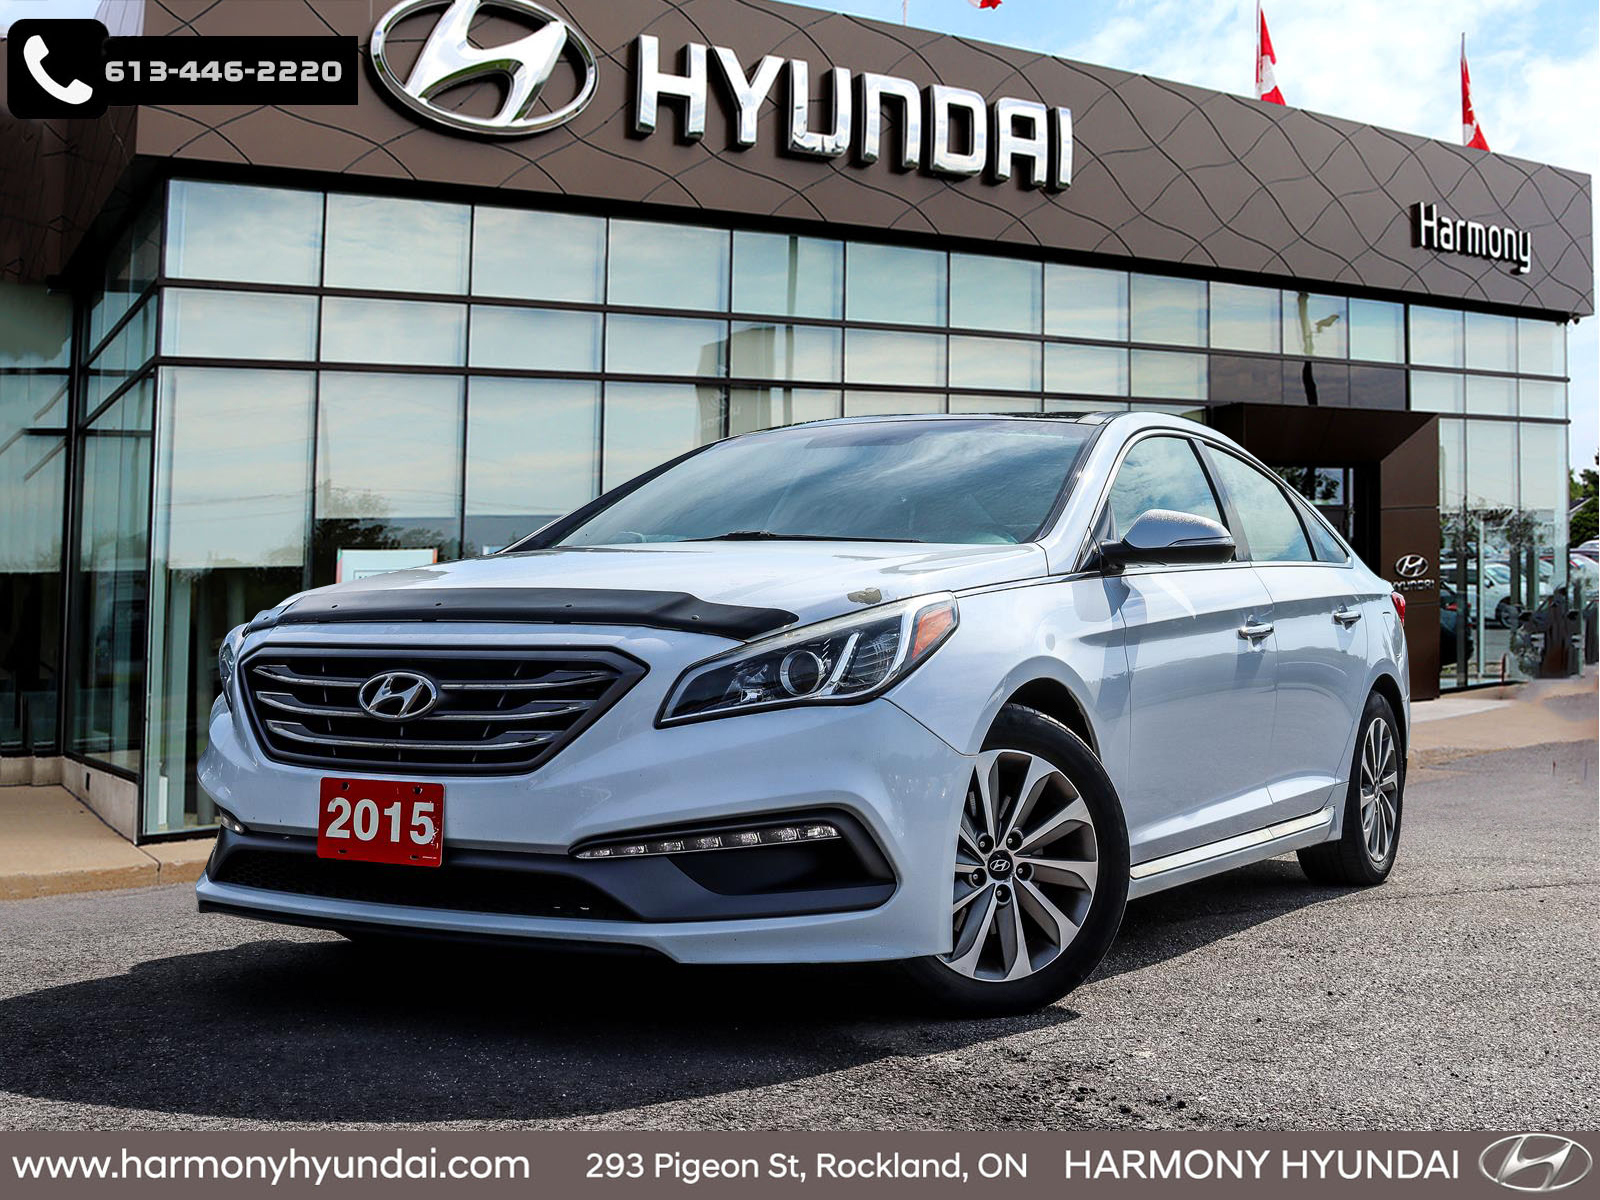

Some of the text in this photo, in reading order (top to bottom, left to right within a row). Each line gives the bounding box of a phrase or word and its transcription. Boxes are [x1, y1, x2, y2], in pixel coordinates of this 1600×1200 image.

[635, 34, 1074, 190] HYUNDAI
[1419, 201, 1531, 274] Harmony
[325, 796, 436, 845] 2015
